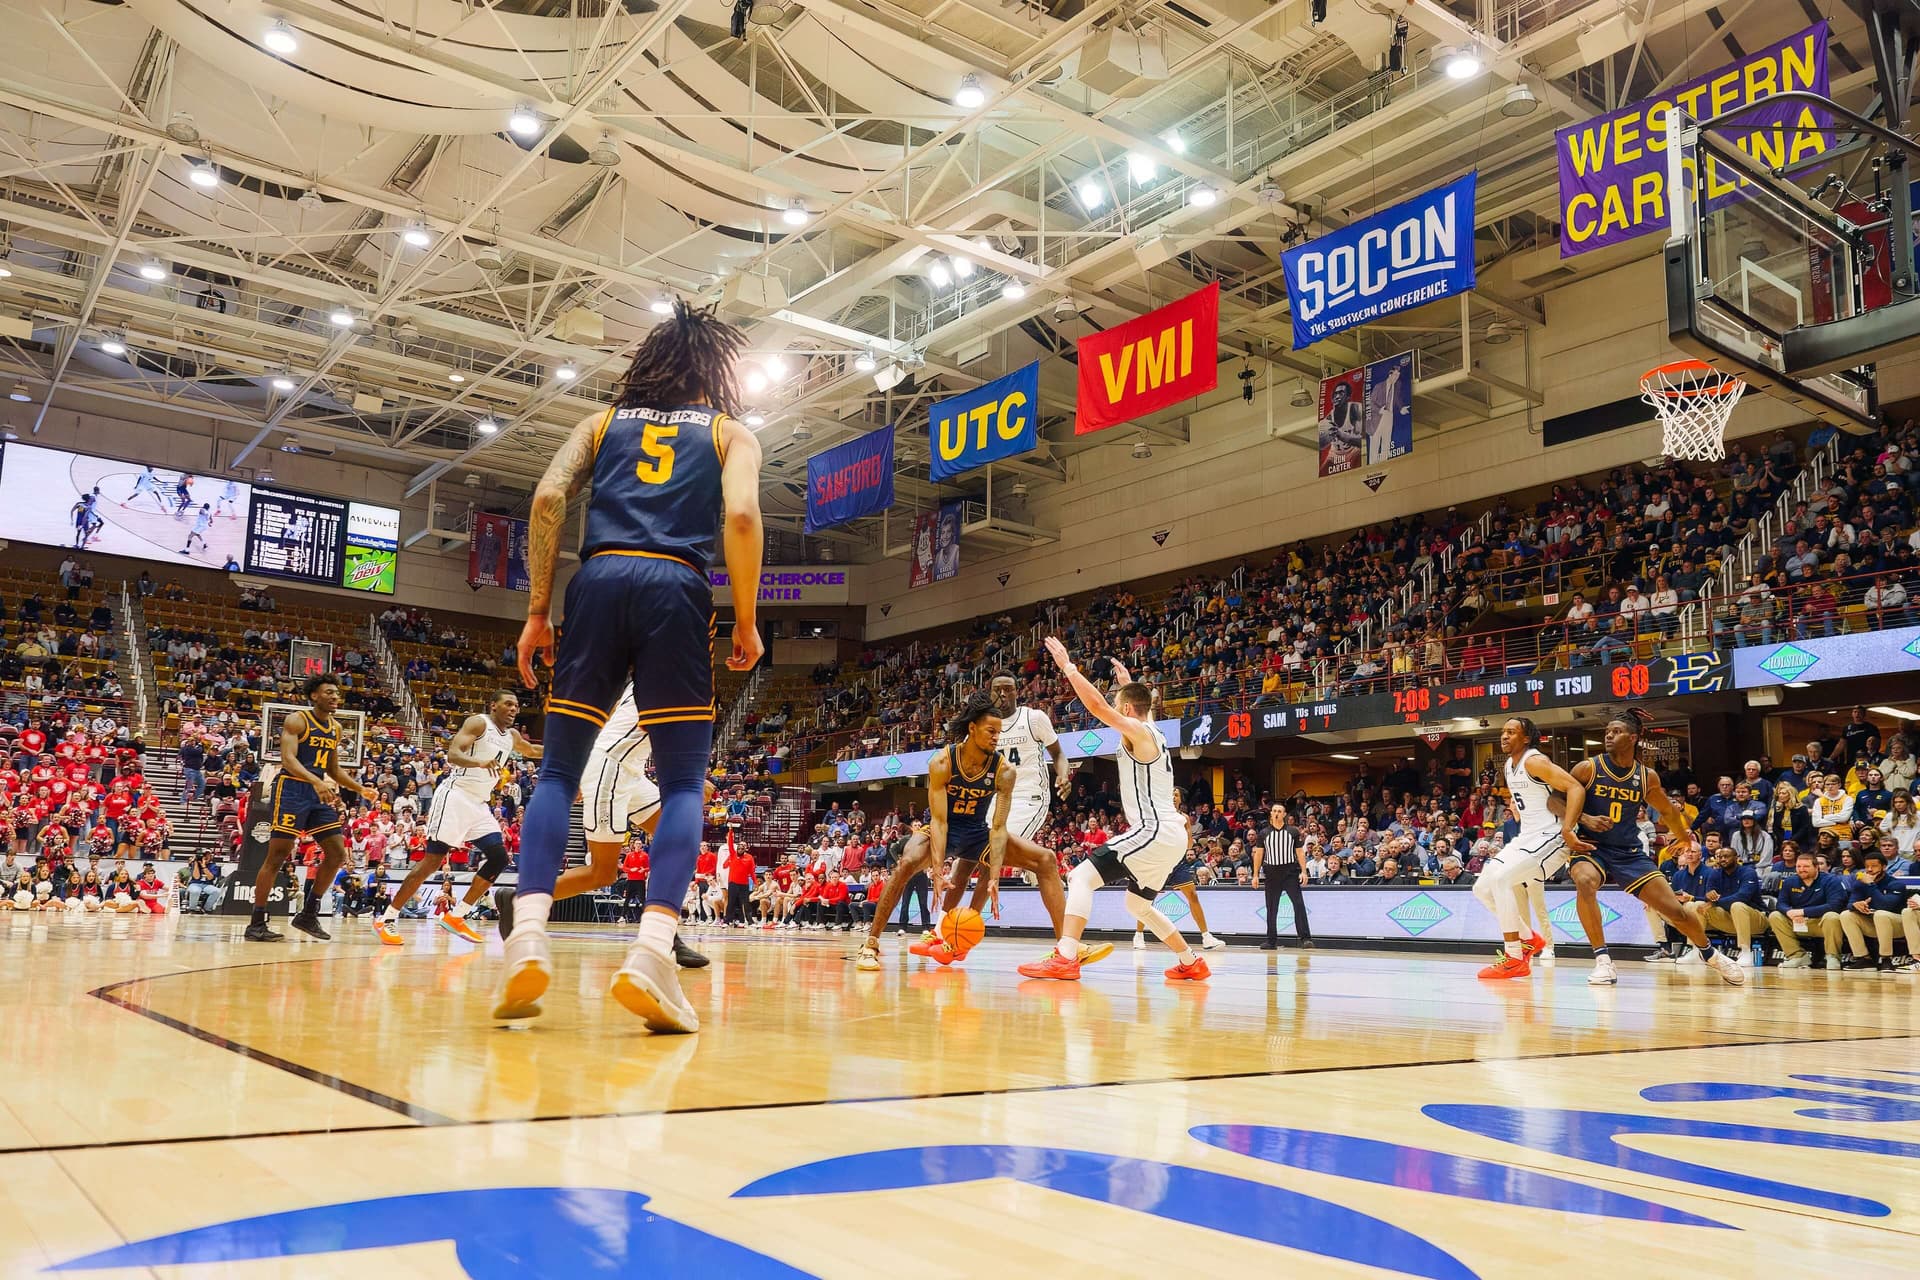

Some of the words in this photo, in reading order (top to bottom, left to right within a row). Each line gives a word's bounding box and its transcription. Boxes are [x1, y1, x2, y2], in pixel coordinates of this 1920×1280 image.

[1568, 35, 1815, 177] WESTERN
[1310, 323, 1326, 336] THE
[1328, 304, 1378, 330] SOUTHERN
[1380, 279, 1448, 314] CONFERENCE
[1099, 318, 1193, 404] VMI
[616, 407, 712, 427] STROTHERS
[939, 391, 1027, 461] UTC
[635, 423, 680, 485] 5
[1328, 461, 1351, 475] CARTER
[816, 454, 881, 506] SAMFORD
[760, 572, 846, 586] CHEROKEE
[1228, 712, 1252, 739] 63
[1263, 712, 1287, 729] SAM
[1314, 703, 1337, 716] FOULS
[1393, 688, 1430, 713] 7:08
[1454, 686, 1485, 700] BONUS
[1489, 681, 1517, 696] FOULS
[1555, 675, 1592, 696] ETSU
[1611, 664, 1649, 698] 60
[1299, 718, 1307, 732] 3
[1324, 715, 1331, 729] 7
[1500, 697, 1509, 709] 6
[1533, 691, 1539, 706] 1
[1426, 733, 1441, 742] 123
[313, 749, 329, 769] 14
[1594, 784, 1641, 803] ETSU
[1609, 801, 1622, 823] 0
[233, 880, 285, 904] ings
